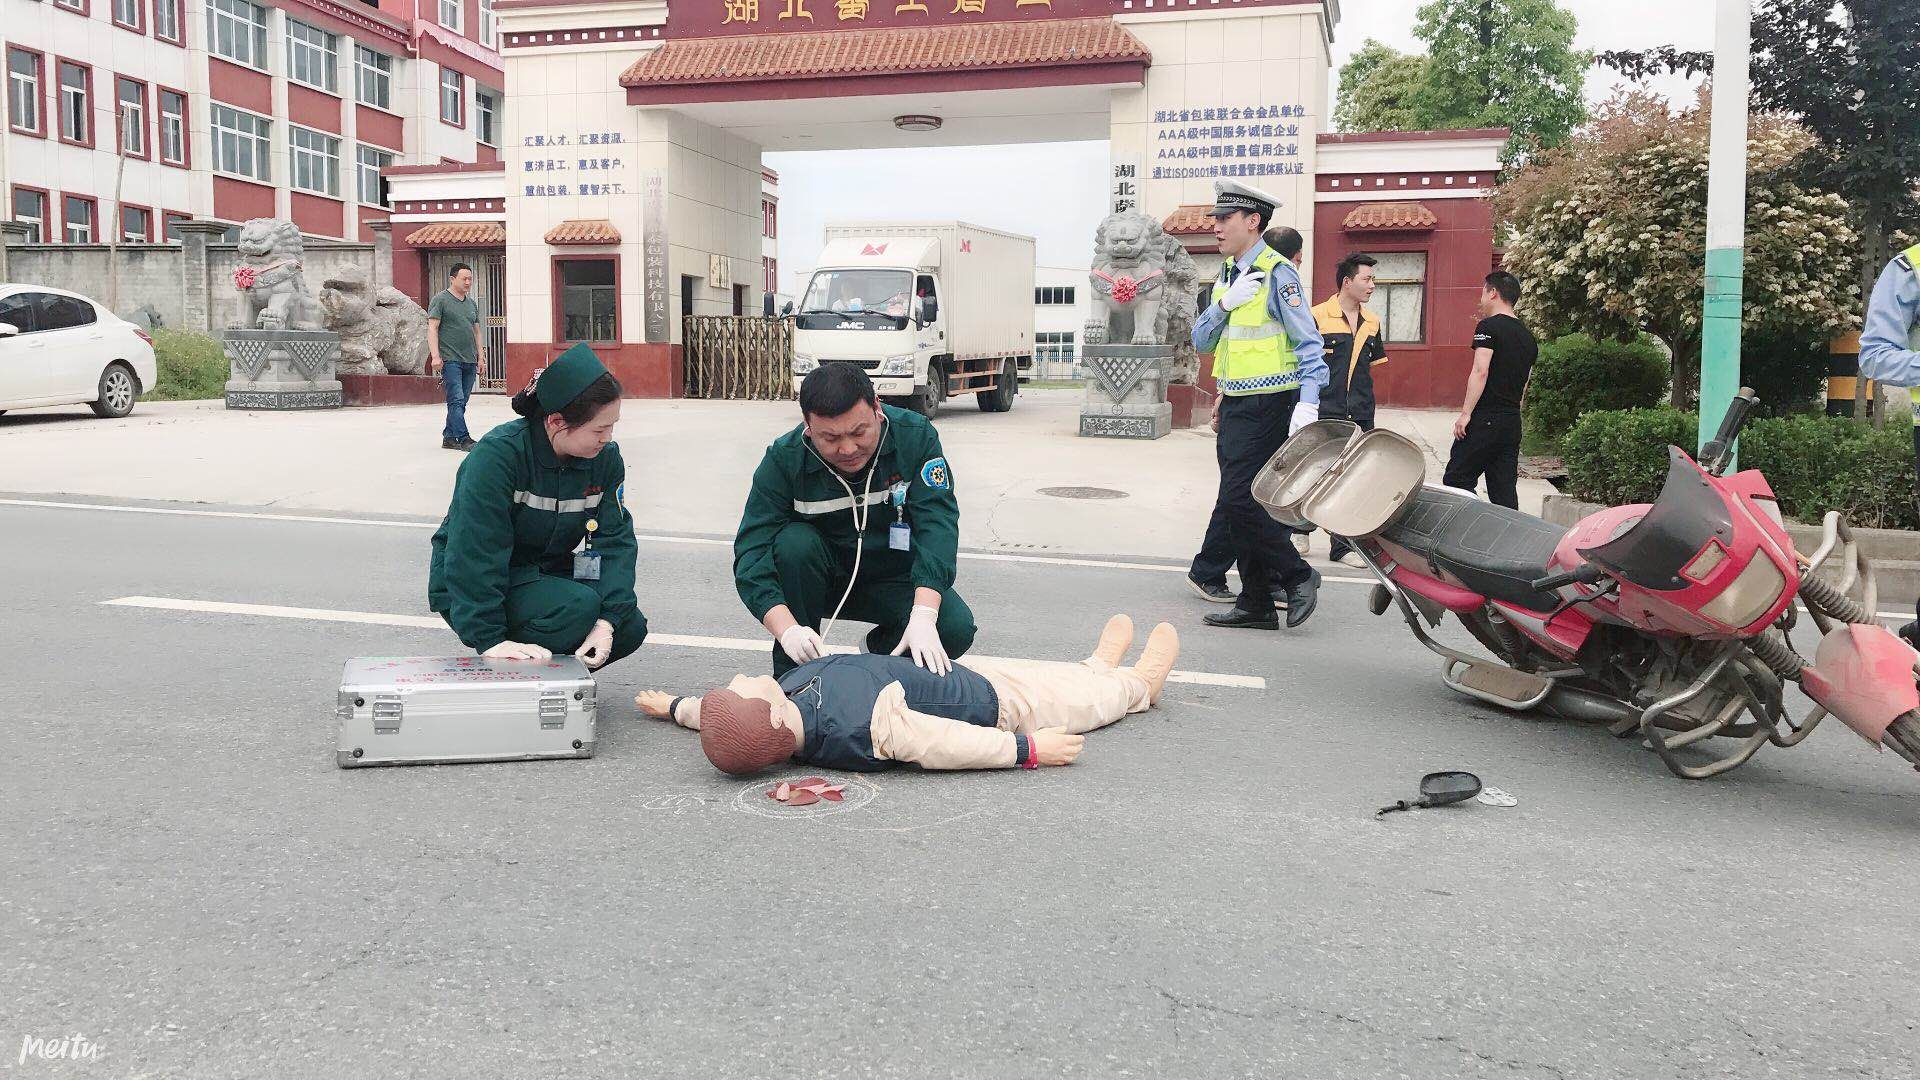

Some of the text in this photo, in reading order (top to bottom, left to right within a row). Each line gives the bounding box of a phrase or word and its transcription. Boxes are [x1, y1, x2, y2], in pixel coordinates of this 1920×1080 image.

[1154, 104, 1305, 123] 湖北省包装联合会会员单位
[1158, 124, 1298, 140] AAA级中国服务诚信企业
[1158, 143, 1298, 159] AAA级中国质量信用企业
[836, 321, 865, 330] JMC
